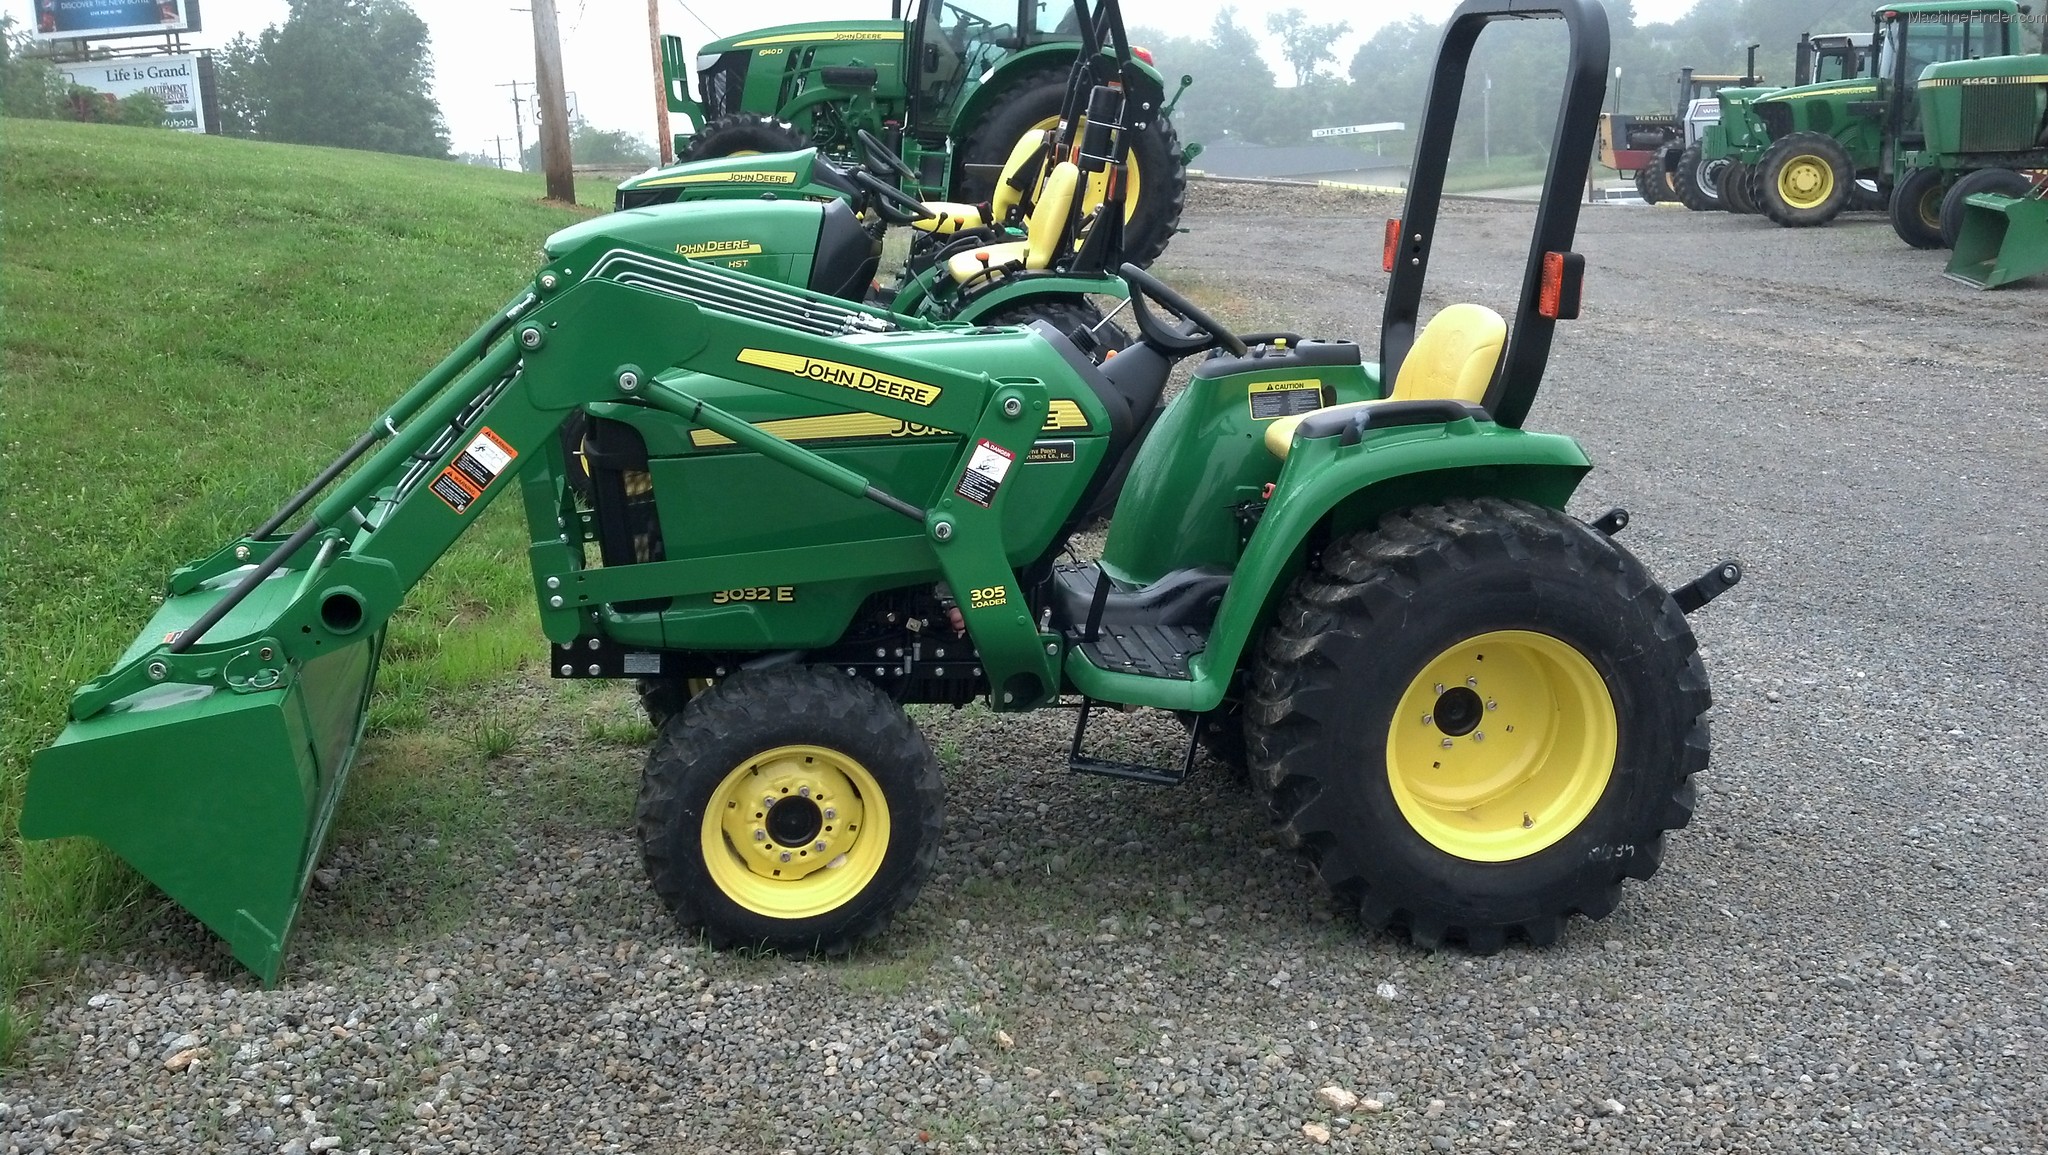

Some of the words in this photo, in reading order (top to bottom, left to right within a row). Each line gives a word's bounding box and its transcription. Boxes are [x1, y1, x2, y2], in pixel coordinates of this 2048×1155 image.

[106, 68, 130, 82] Life
[133, 67, 144, 80] is
[147, 64, 190, 79] Grand.
[1963, 77, 1997, 85] 4440
[1317, 127, 1359, 136] DIESEL
[728, 173, 755, 182] JOHN
[755, 173, 788, 183] DEERE
[675, 243, 706, 254] JOHN
[707, 240, 749, 251] DEERE
[728, 259, 748, 268] HST
[794, 359, 855, 385] JOHN
[858, 371, 929, 403] DEERE
[1274, 382, 1304, 390] CAUTION
[990, 444, 1011, 458] DANGER
[713, 587, 771, 604] 3032
[777, 586, 794, 601] E
[970, 585, 1006, 601] 305
[971, 598, 1007, 609] LOADER
